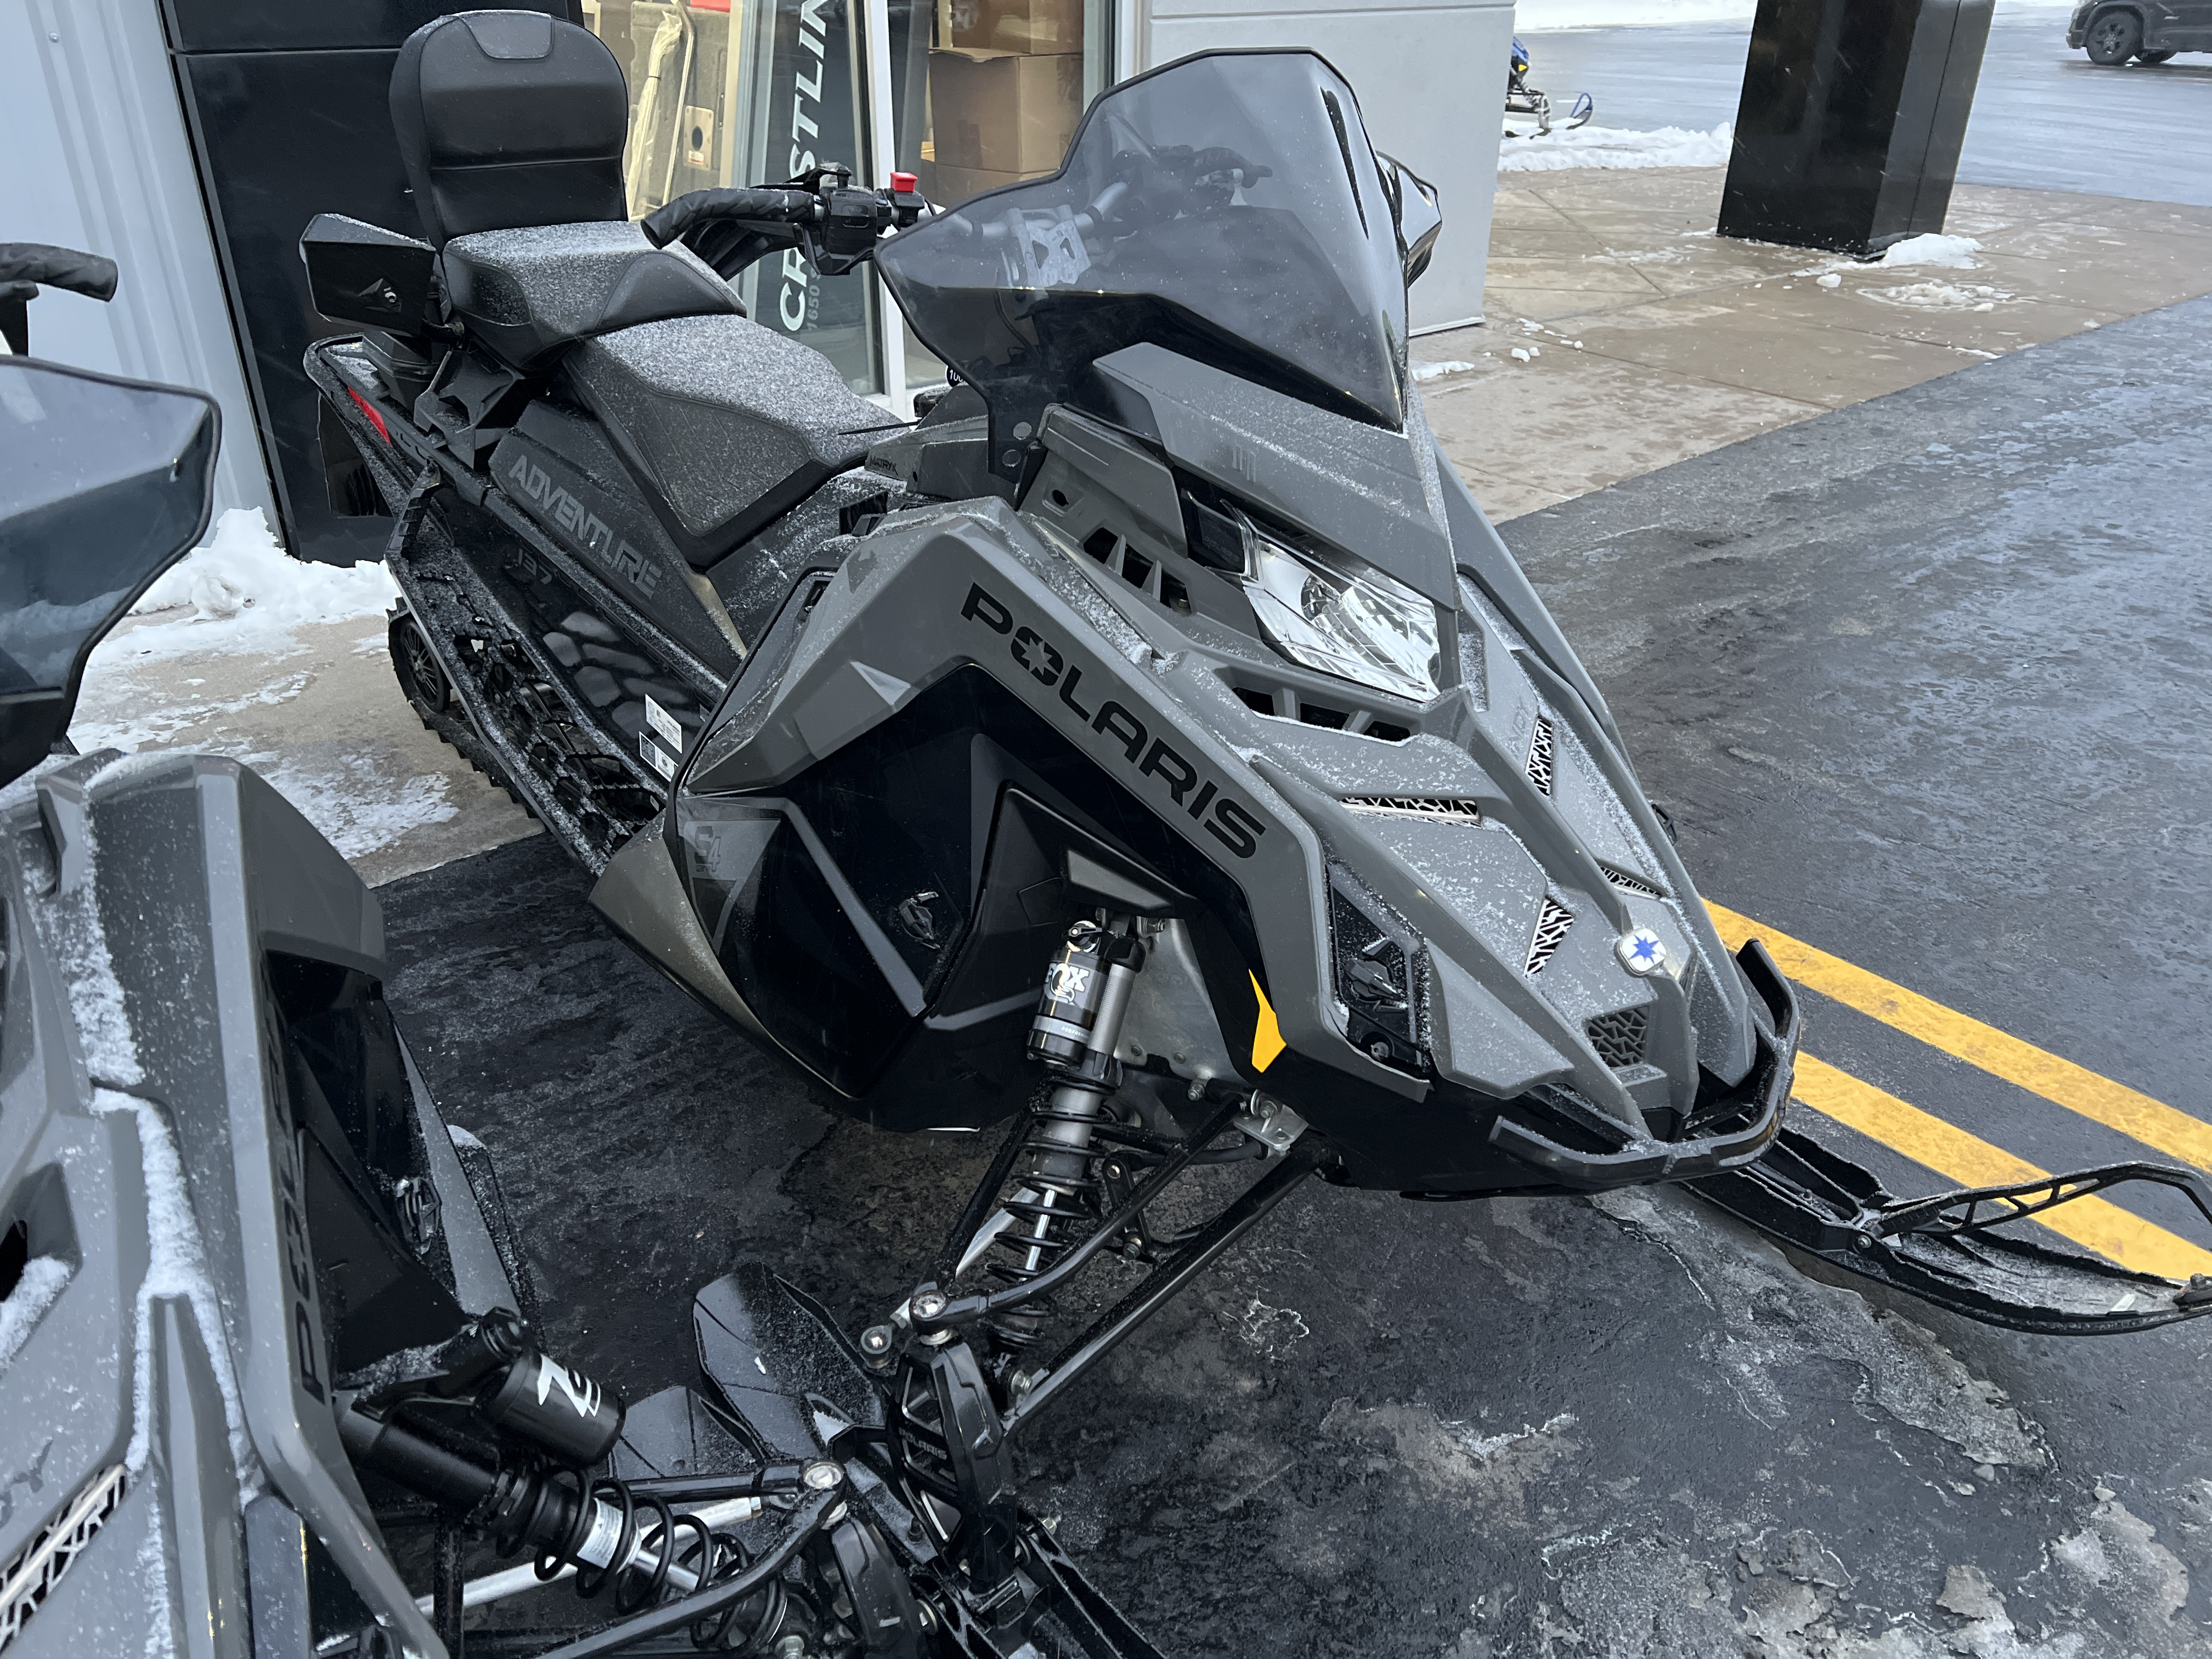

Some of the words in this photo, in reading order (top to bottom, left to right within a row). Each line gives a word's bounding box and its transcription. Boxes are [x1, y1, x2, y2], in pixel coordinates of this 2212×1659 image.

[780, 0, 828, 331] CRSTLIN
[806, 285, 820, 331] 1650
[508, 454, 663, 600] ADVENTURE
[961, 582, 1266, 859] POLARIS
[1045, 963, 1089, 1002] FOX
[1061, 1025, 1088, 1038] PERFOR
[899, 1427, 947, 1460] POLARIS
